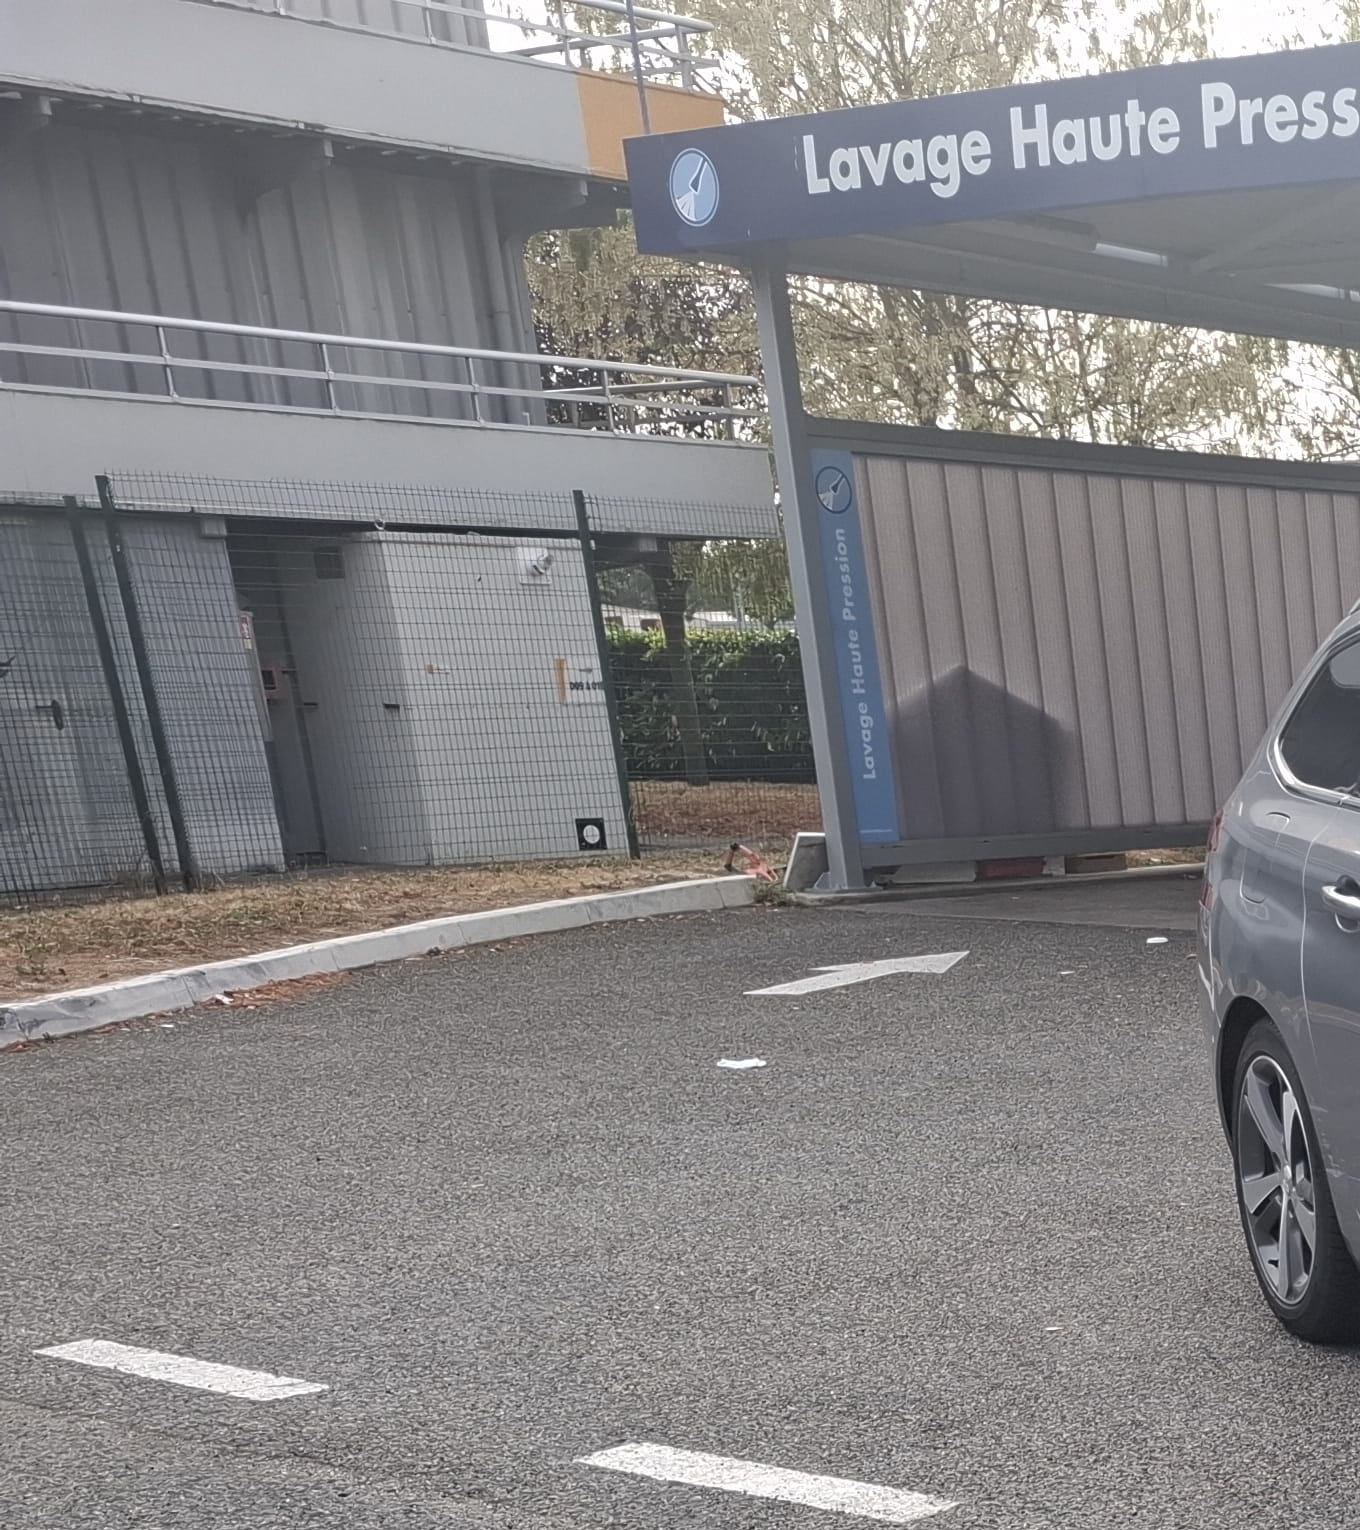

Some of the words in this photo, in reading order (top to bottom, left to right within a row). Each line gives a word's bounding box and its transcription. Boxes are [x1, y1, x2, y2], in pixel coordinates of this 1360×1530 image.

[804, 134, 992, 198] Lavage
[1010, 99, 1181, 170] Haute
[834, 528, 856, 621] Pression
[848, 629, 866, 694] Haute
[858, 702, 877, 780] Lavage
